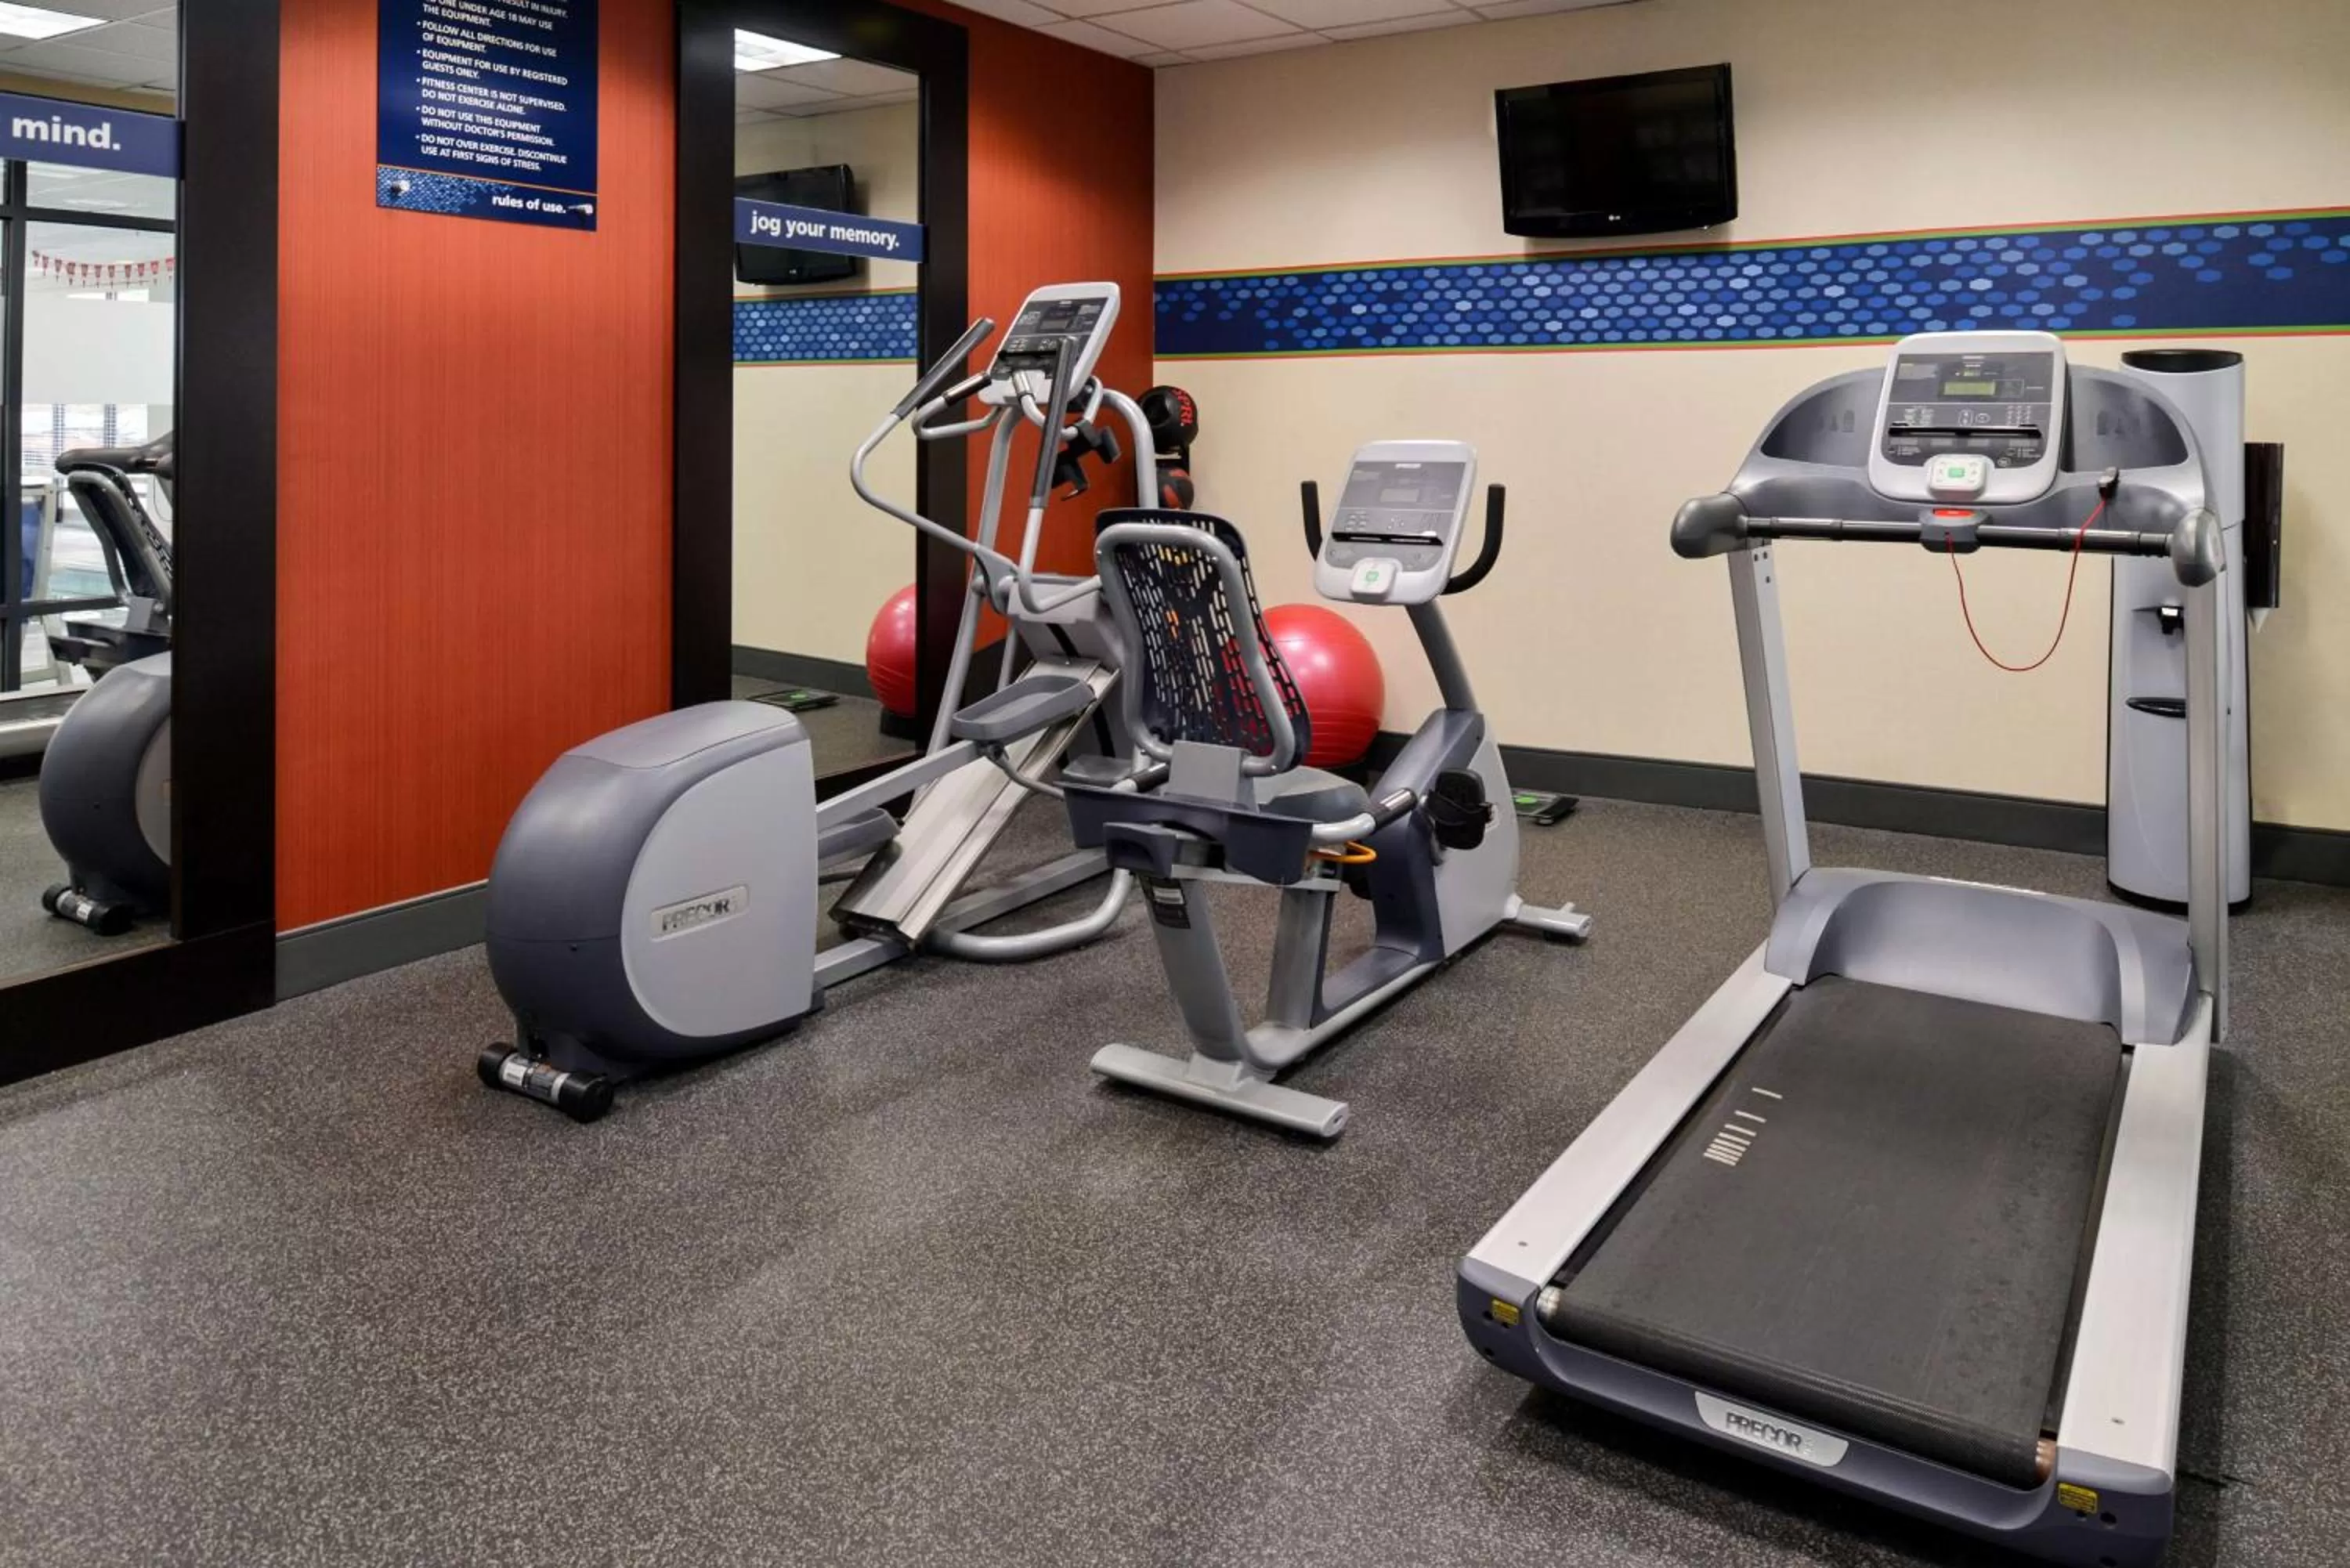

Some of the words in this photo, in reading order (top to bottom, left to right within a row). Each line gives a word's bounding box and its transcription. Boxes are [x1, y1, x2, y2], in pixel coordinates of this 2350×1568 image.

[489, 9, 506, 20] AGE
[519, 16, 537, 25] MAY
[539, 20, 551, 31] USE
[12, 115, 121, 151] mind.
[492, 194, 523, 208] rules
[526, 198, 540, 210] of
[542, 202, 566, 214] use.
[750, 210, 781, 236] jog
[785, 220, 826, 238] your
[830, 225, 900, 251] memory.
[1726, 1412, 1802, 1452] PRECOR
